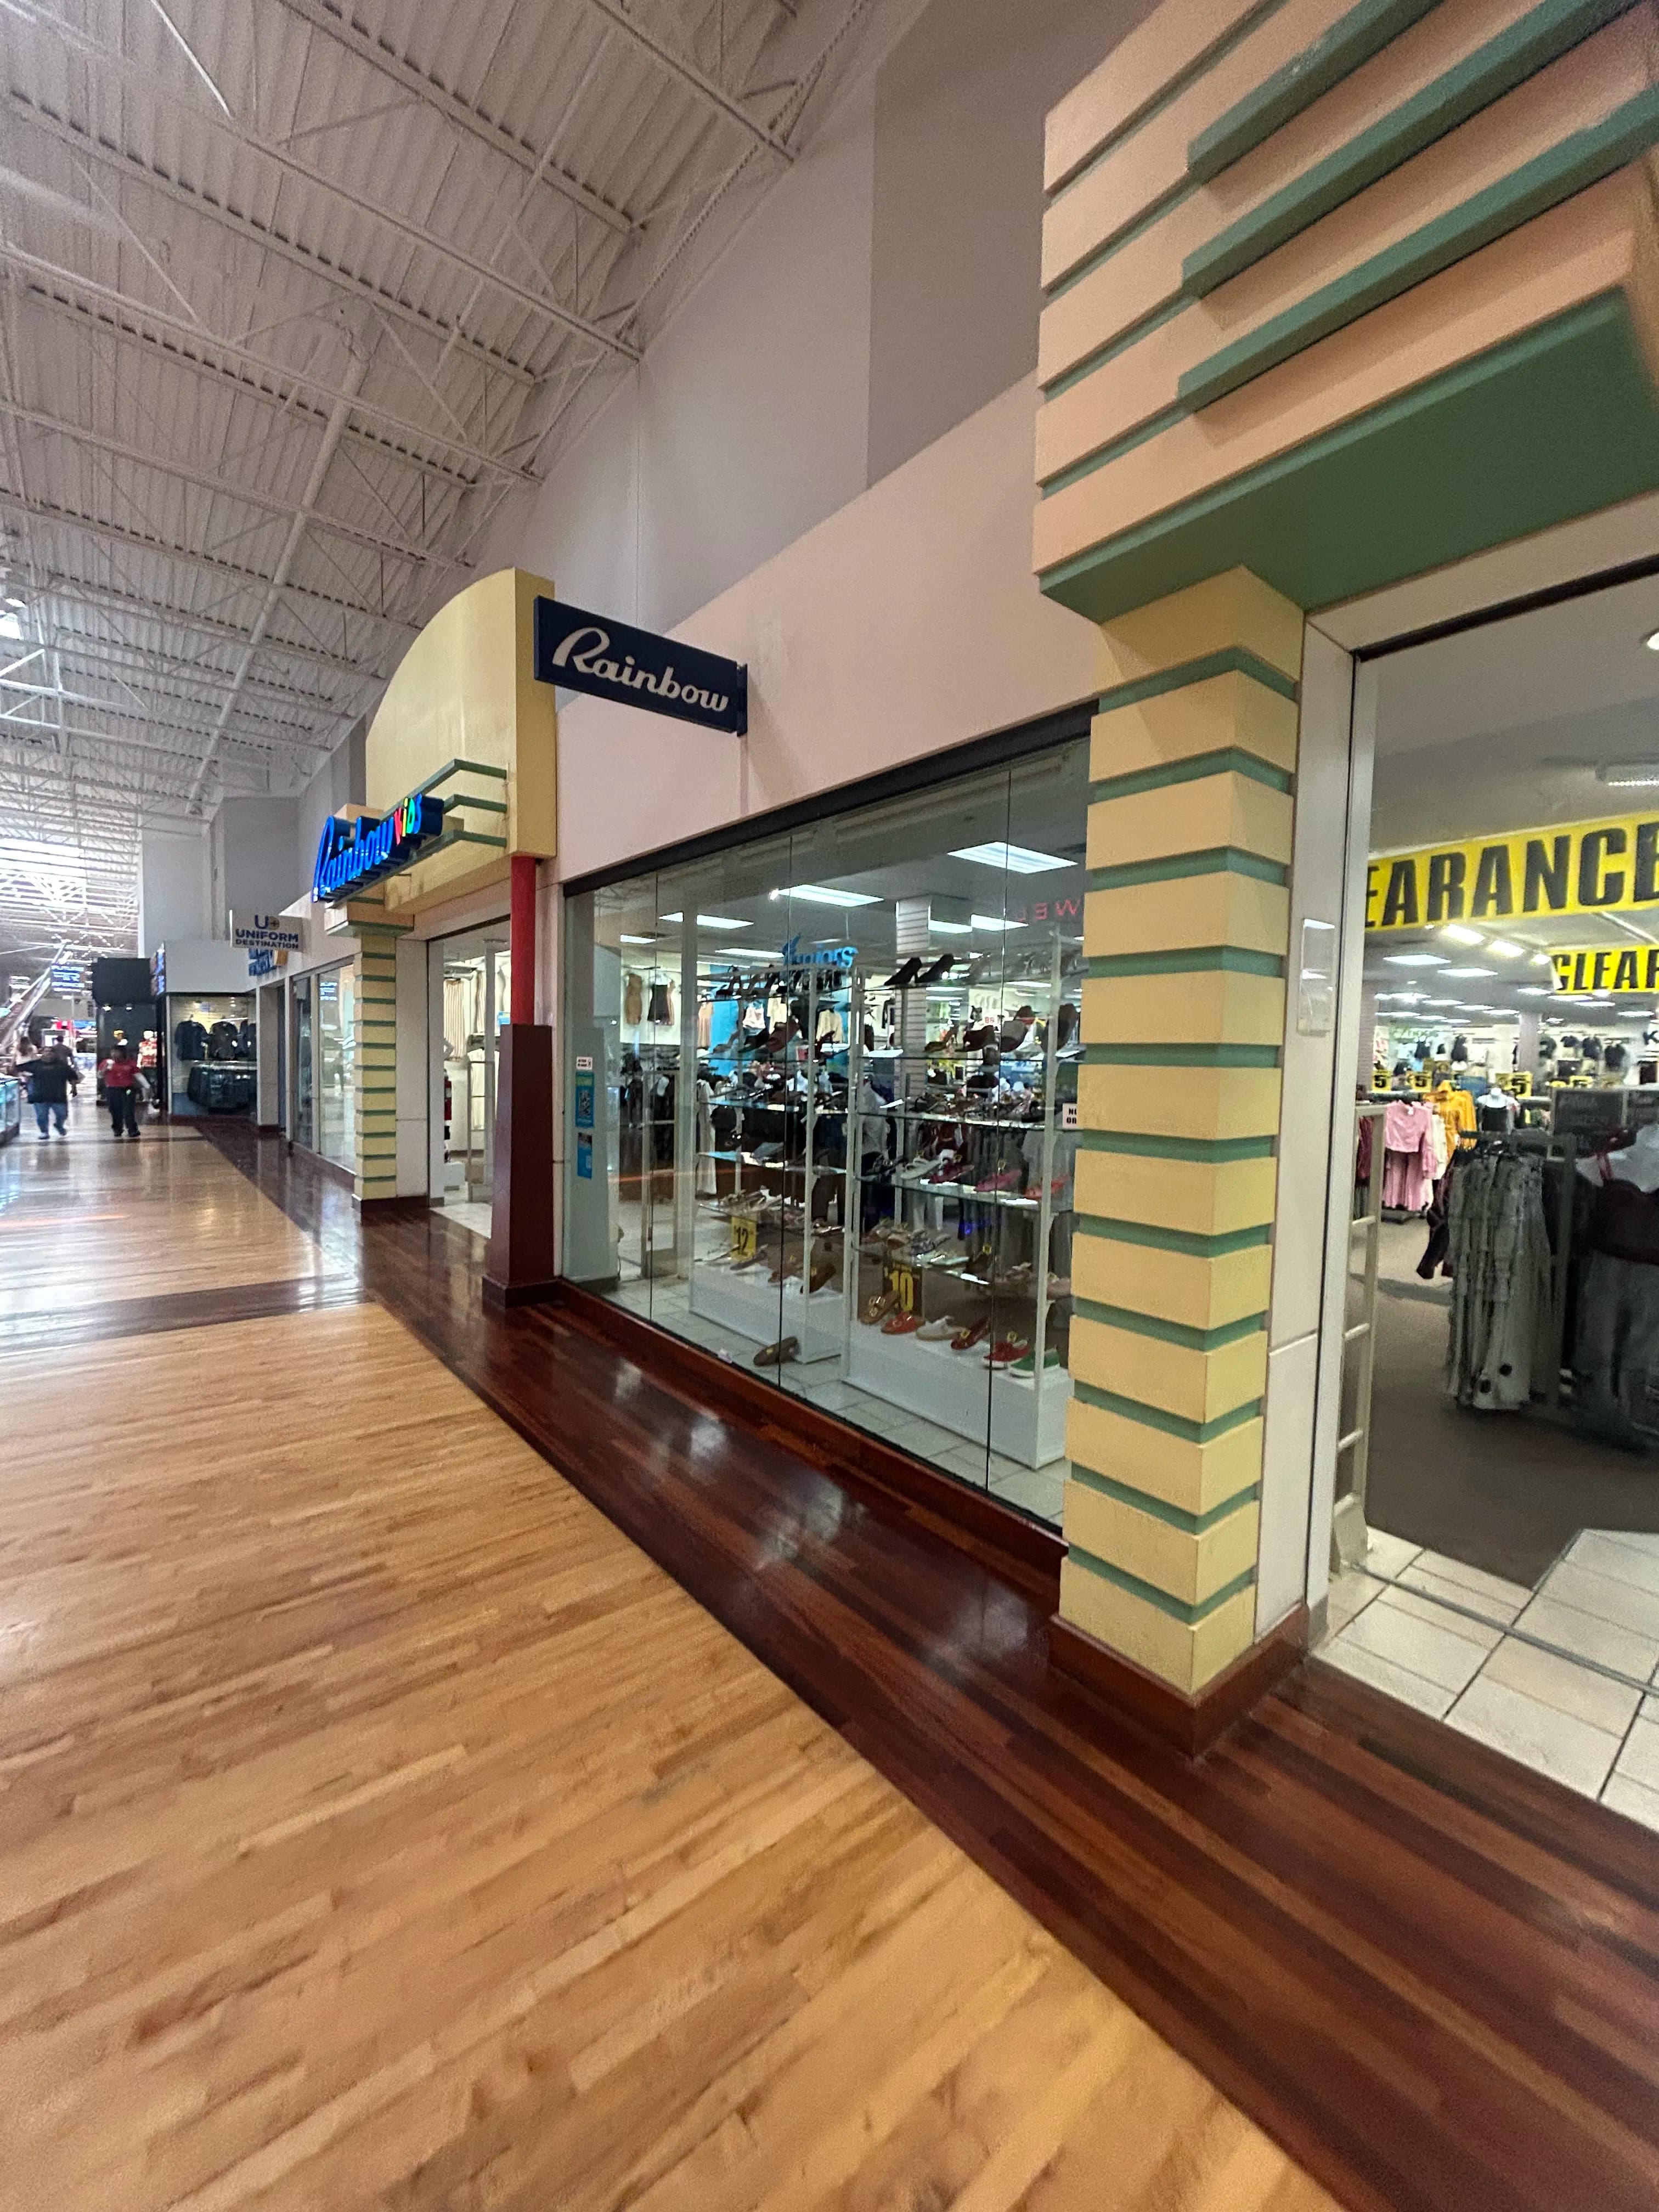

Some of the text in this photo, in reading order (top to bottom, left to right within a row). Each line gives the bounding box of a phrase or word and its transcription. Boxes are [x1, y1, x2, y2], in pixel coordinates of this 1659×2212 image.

[552, 627, 729, 712] Rainbow
[312, 815, 394, 903] Rainbow
[235, 928, 299, 943] UNIFORM
[235, 939, 299, 949] DESTINATION
